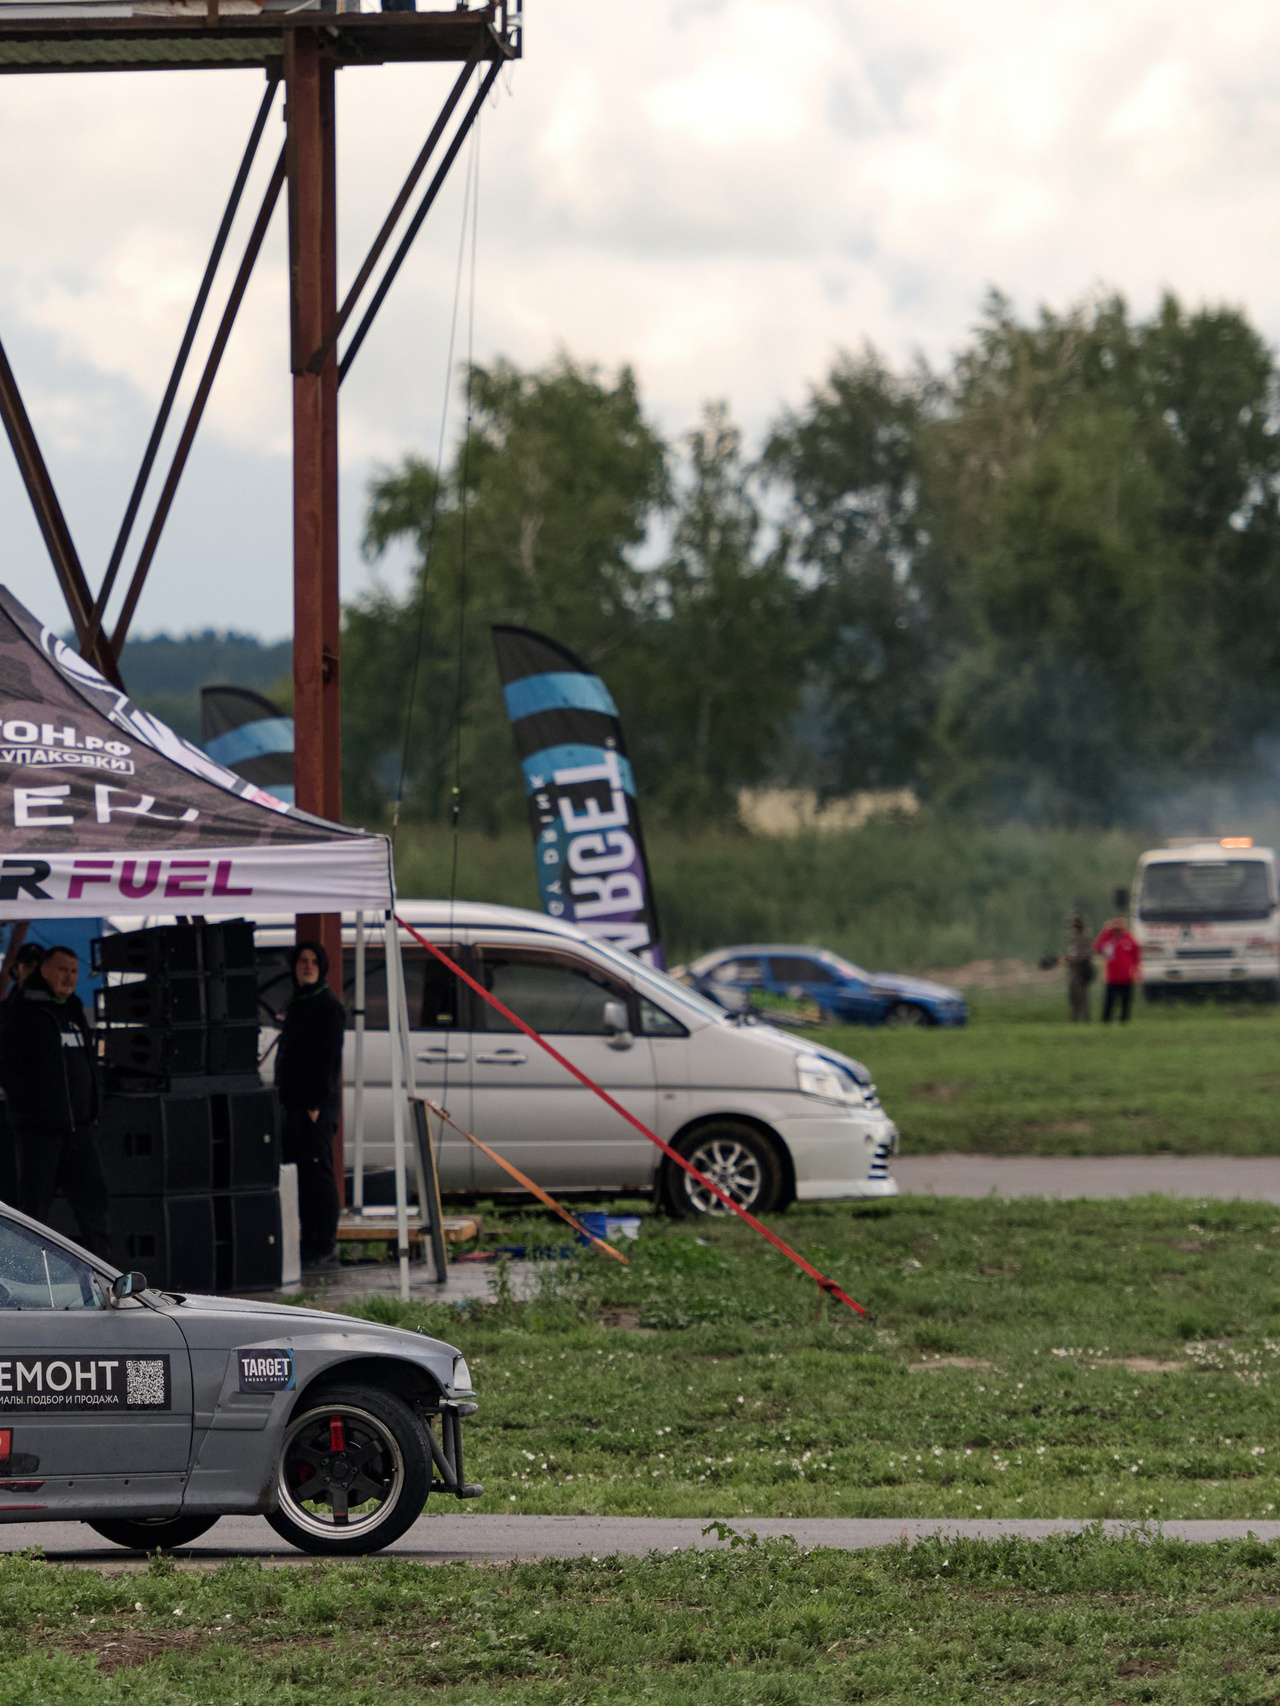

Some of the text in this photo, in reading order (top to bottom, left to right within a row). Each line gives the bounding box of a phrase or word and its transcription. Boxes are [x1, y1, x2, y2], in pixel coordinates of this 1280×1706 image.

[1, 749, 126, 771] УПАКОВКИ
[67, 859, 255, 900] FUEL
[241, 1358, 290, 1376] TARGET
[27, 1395, 65, 1405] ПОДБОР
[66, 1396, 73, 1404] И
[74, 1395, 119, 1404] ПРОДАЖА
